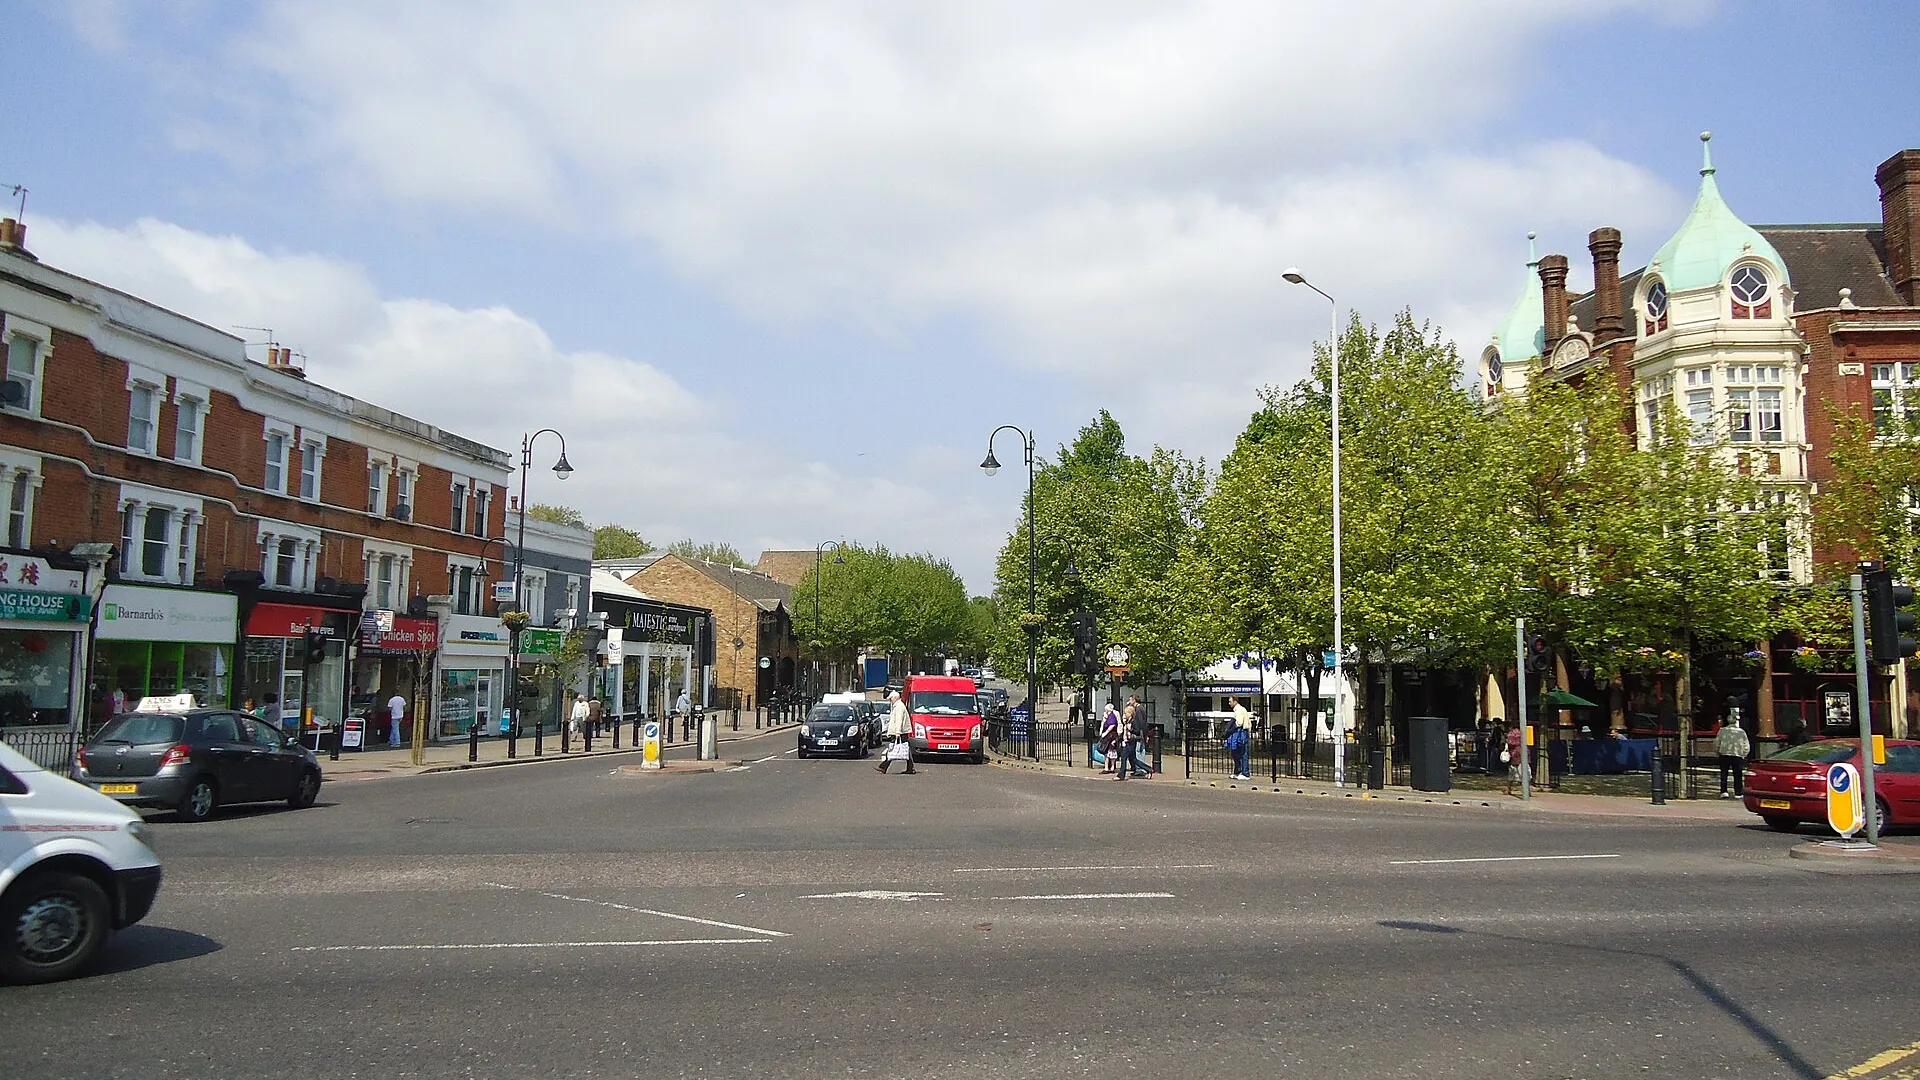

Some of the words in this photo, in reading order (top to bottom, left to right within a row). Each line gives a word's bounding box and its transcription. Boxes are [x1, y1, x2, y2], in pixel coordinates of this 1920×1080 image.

[69, 579, 79, 588] 72
[19, 594, 65, 608] HOUSE
[4, 605, 15, 613] TO
[17, 606, 37, 614] TAKE
[37, 607, 59, 615] AWAY
[118, 606, 164, 620] Barnardo's
[382, 629, 414, 642] Chicken
